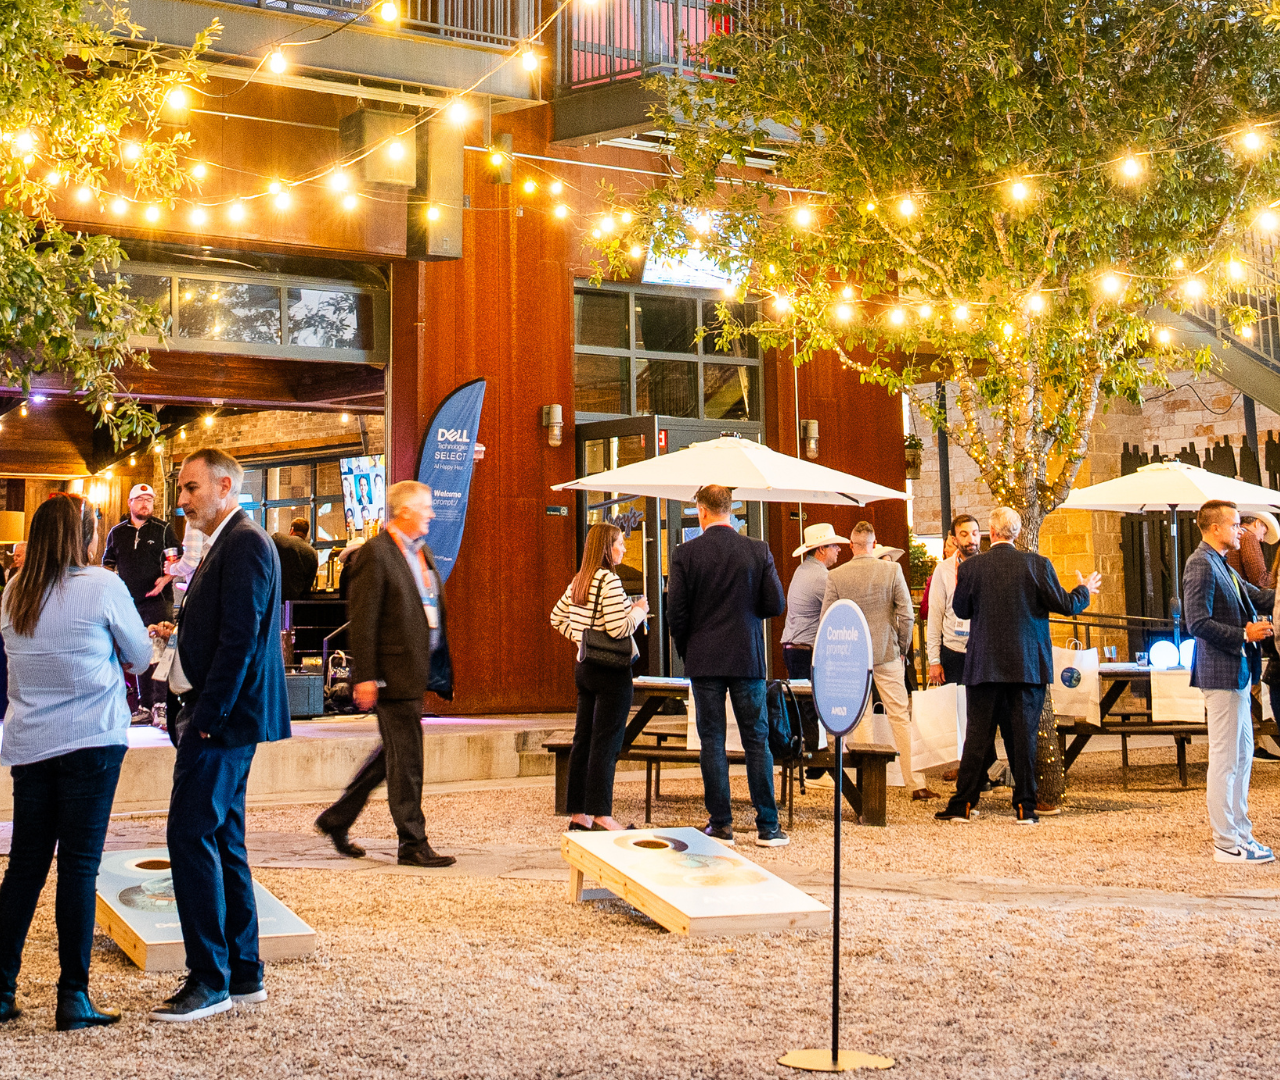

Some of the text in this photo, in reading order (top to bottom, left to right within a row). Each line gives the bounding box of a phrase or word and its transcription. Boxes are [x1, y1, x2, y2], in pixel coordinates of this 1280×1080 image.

[437, 428, 470, 442] DELL
[434, 451, 467, 461] SELECT
[434, 490, 462, 498] Welcome
[827, 626, 859, 641] Cornhole
